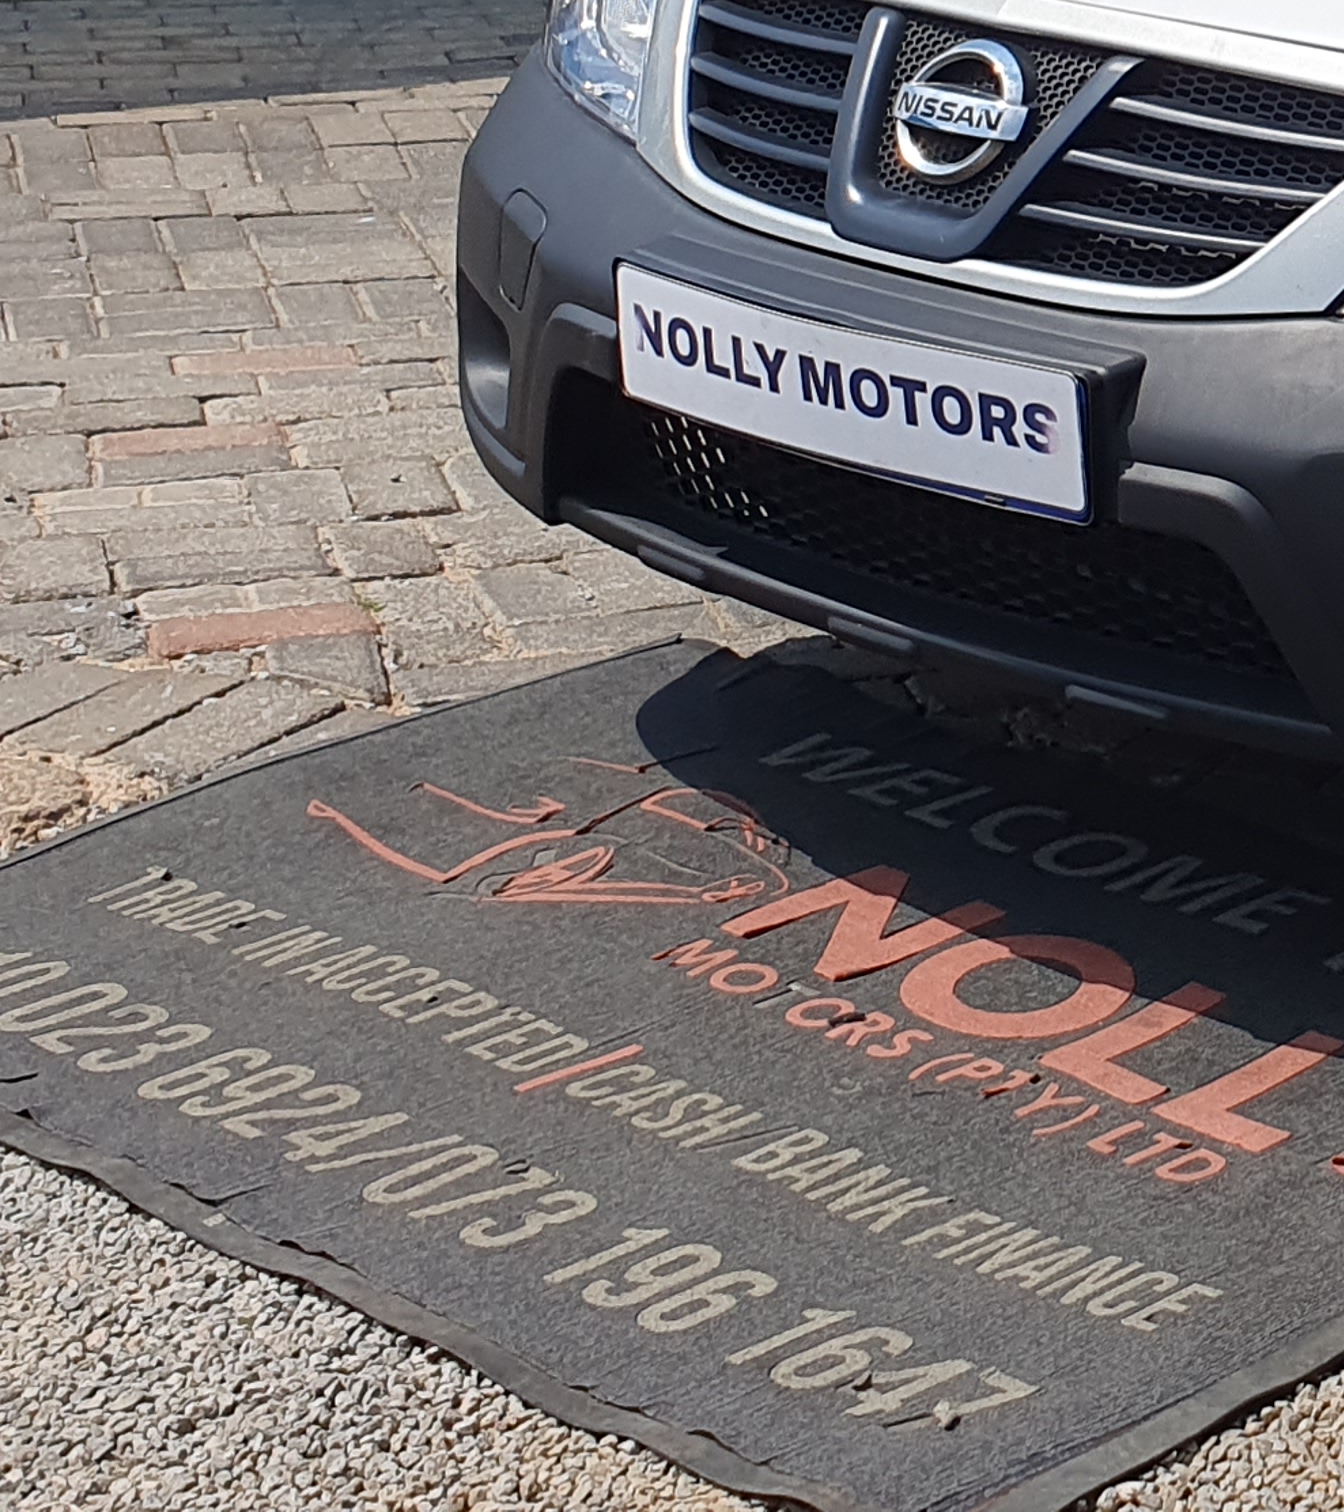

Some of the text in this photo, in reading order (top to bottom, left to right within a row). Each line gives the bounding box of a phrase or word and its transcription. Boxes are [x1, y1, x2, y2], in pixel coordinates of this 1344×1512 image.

[897, 90, 1004, 133] NISSAN
[632, 303, 1060, 456] NOLLY MOTORS
[759, 732, 1331, 934] WELCOME
[87, 864, 288, 944] TRADE
[232, 925, 343, 968] IN
[901, 1209, 1225, 1332] FINANCE
[909, 1052, 1101, 1136] (PTY)
[1086, 1120, 1228, 1182] LTD
[0, 982, 216, 1073] 023
[544, 1226, 778, 1334] 196
[725, 1308, 1040, 1431] 1647
